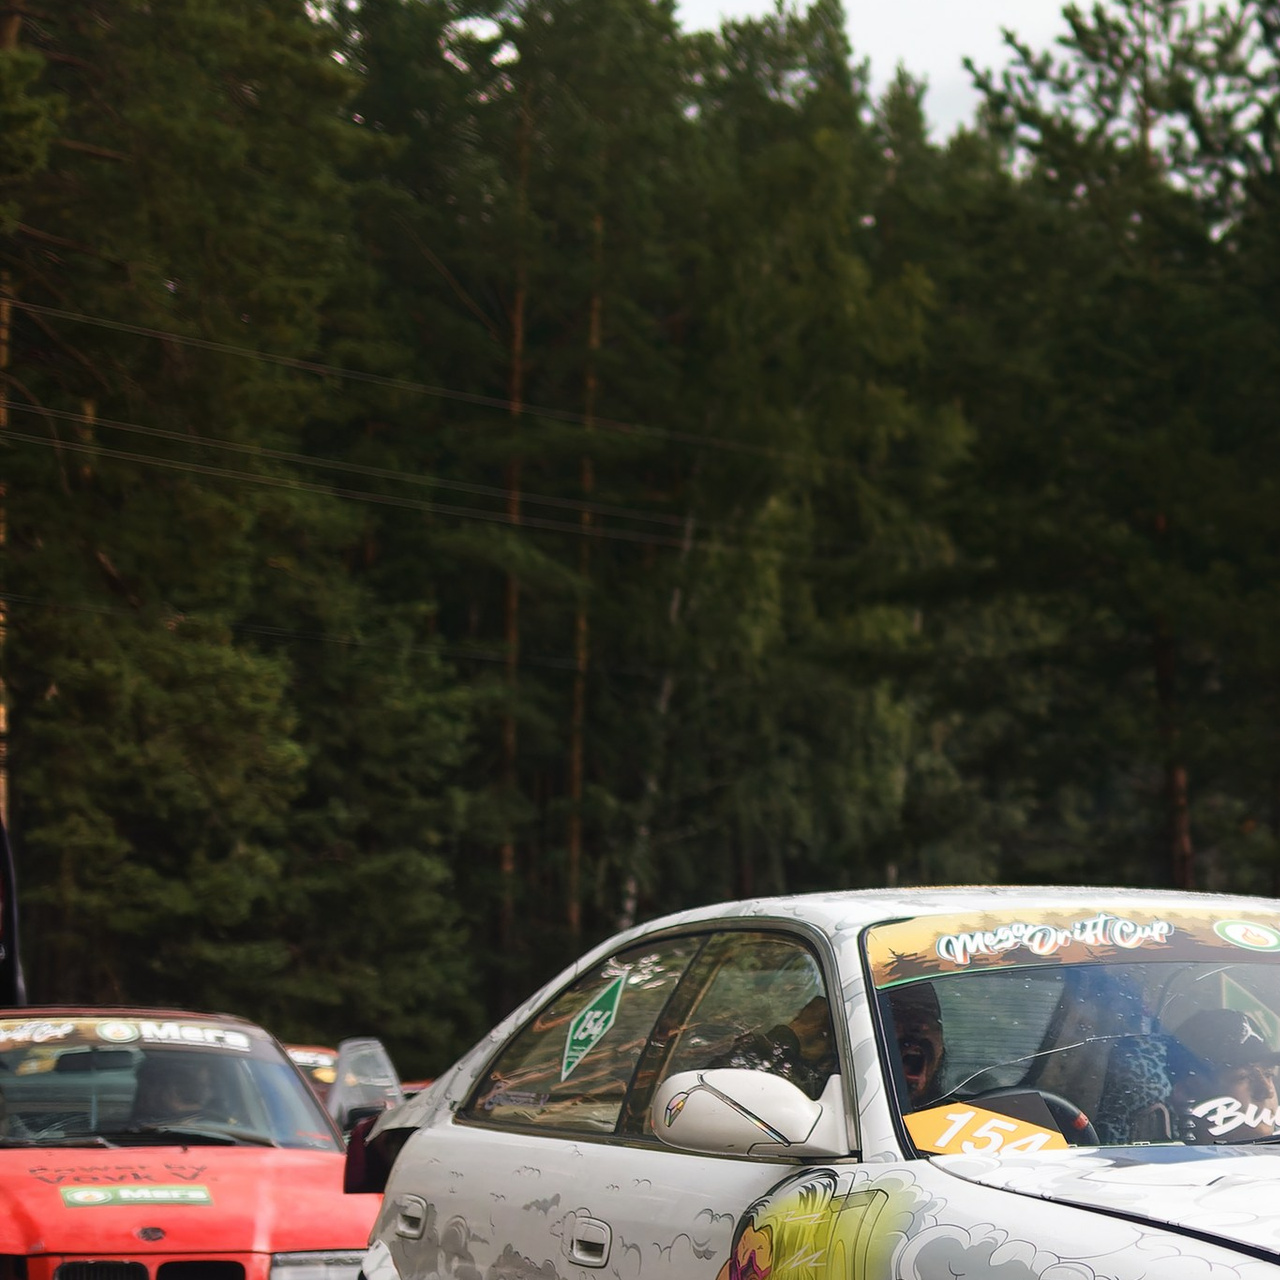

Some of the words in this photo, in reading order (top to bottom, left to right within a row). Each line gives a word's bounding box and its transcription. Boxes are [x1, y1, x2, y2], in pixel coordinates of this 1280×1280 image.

[936, 923, 1030, 965] Mega
[1023, 913, 1113, 955] Drift
[1111, 918, 1174, 949] Cup
